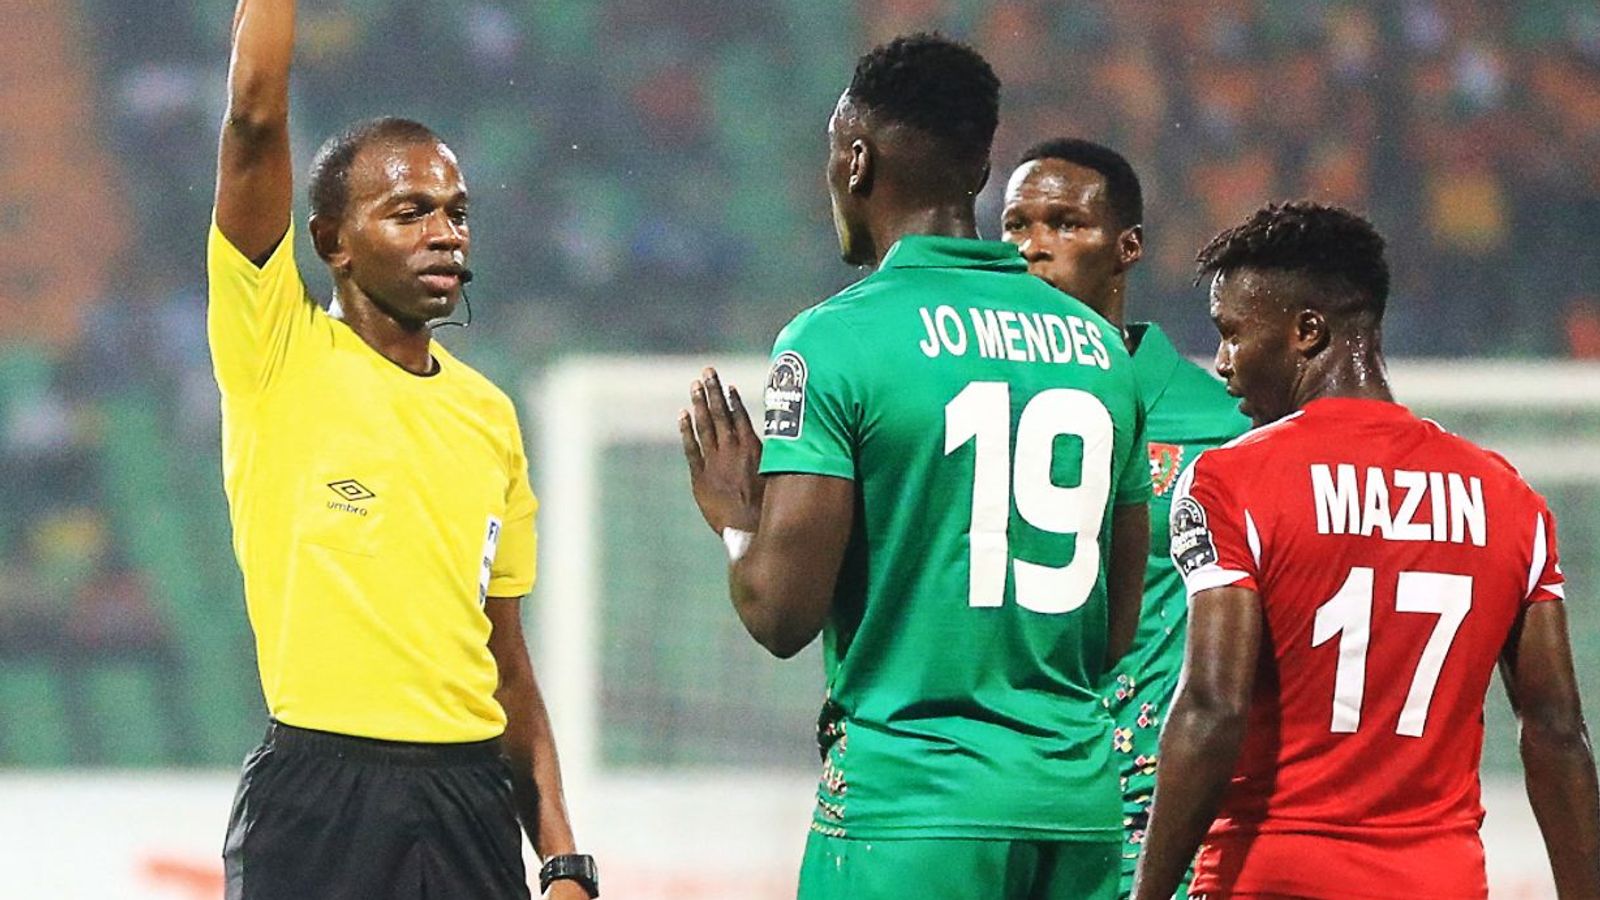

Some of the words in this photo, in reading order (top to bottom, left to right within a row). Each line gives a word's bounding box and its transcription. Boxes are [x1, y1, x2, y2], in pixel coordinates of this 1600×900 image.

[919, 304, 967, 358] JO
[968, 307, 1111, 370] MENDES
[326, 501, 368, 517] umbro
[944, 381, 1114, 614] 19
[1310, 463, 1486, 547] MAZIN
[1312, 566, 1473, 738] 17
